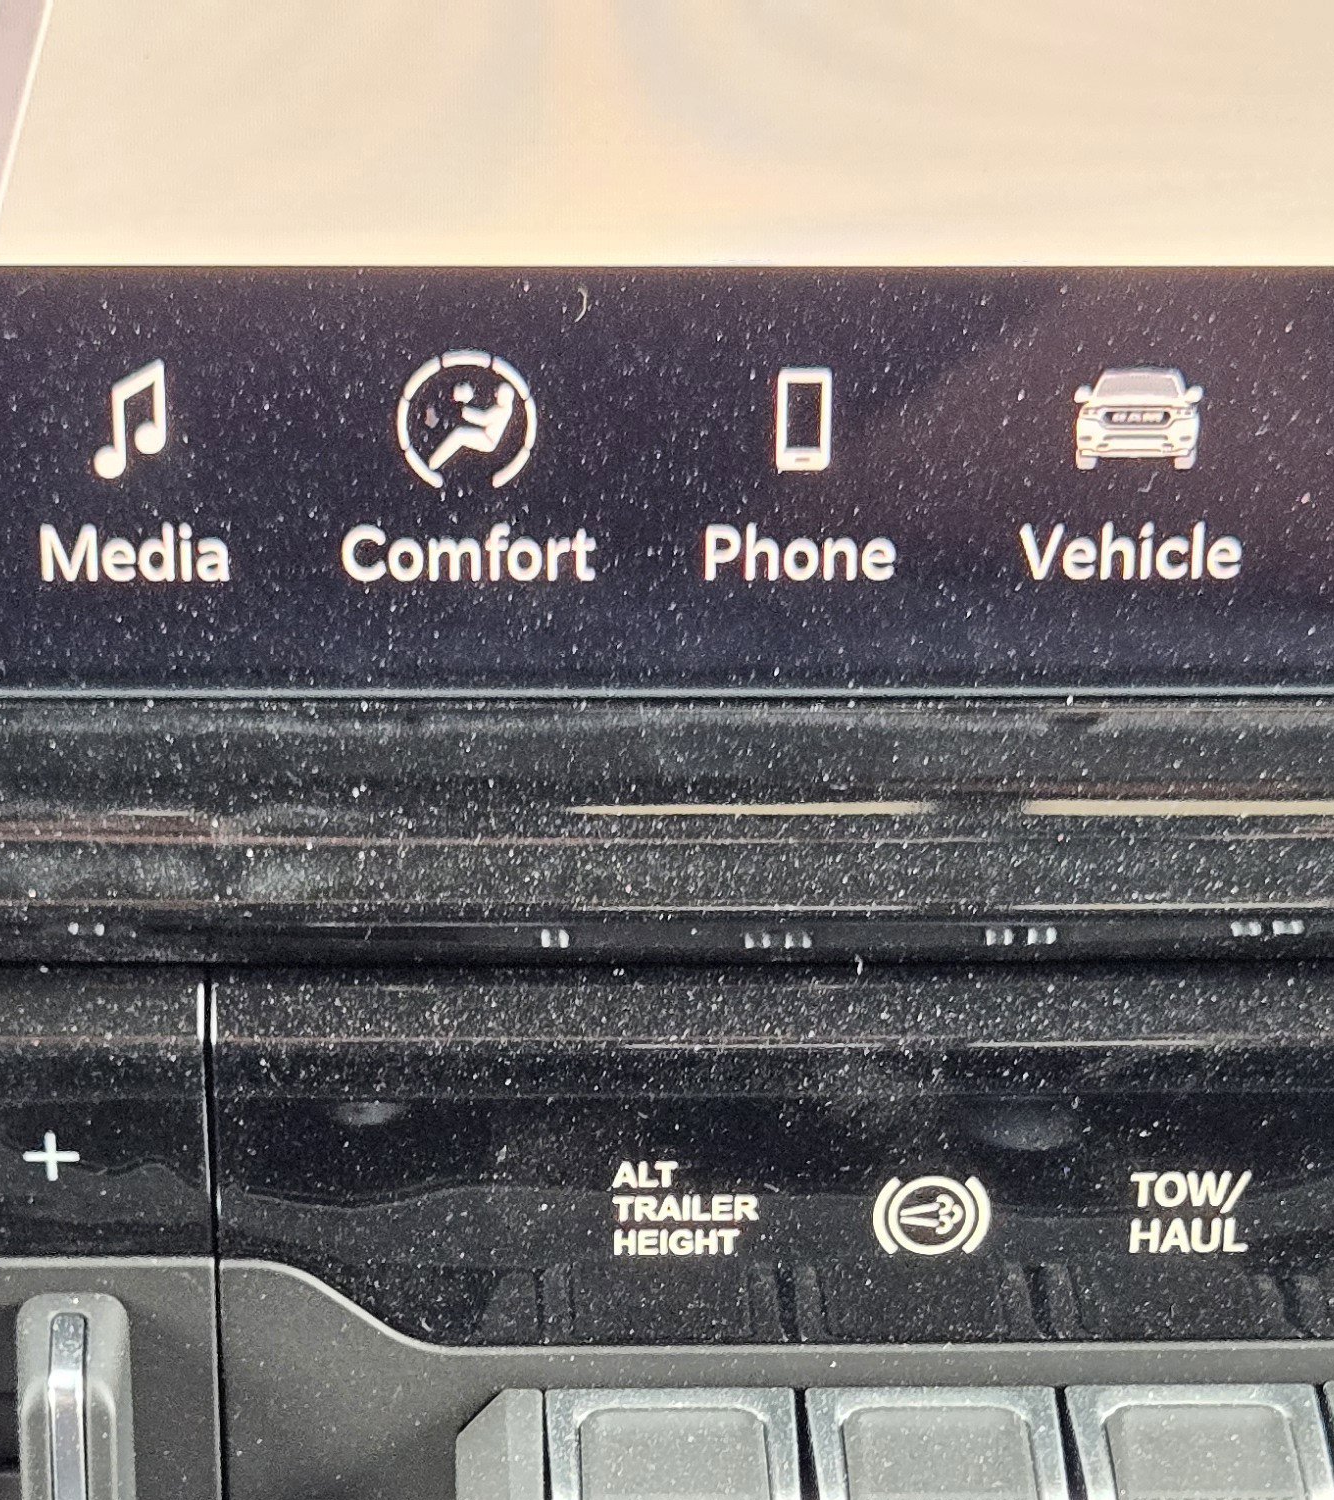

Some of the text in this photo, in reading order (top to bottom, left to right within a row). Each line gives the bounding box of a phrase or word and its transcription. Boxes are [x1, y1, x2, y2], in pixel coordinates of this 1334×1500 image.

[39, 522, 232, 582] Media
[341, 522, 597, 583] Comfort
[704, 522, 896, 582] Phone
[1019, 521, 1242, 581] Vehicle
[611, 1160, 679, 1189] ALT
[1130, 1170, 1252, 1213] TOW/
[611, 1194, 760, 1223] TRAILER
[613, 1228, 741, 1256] HEIGHT
[1128, 1216, 1249, 1254] HAUL
